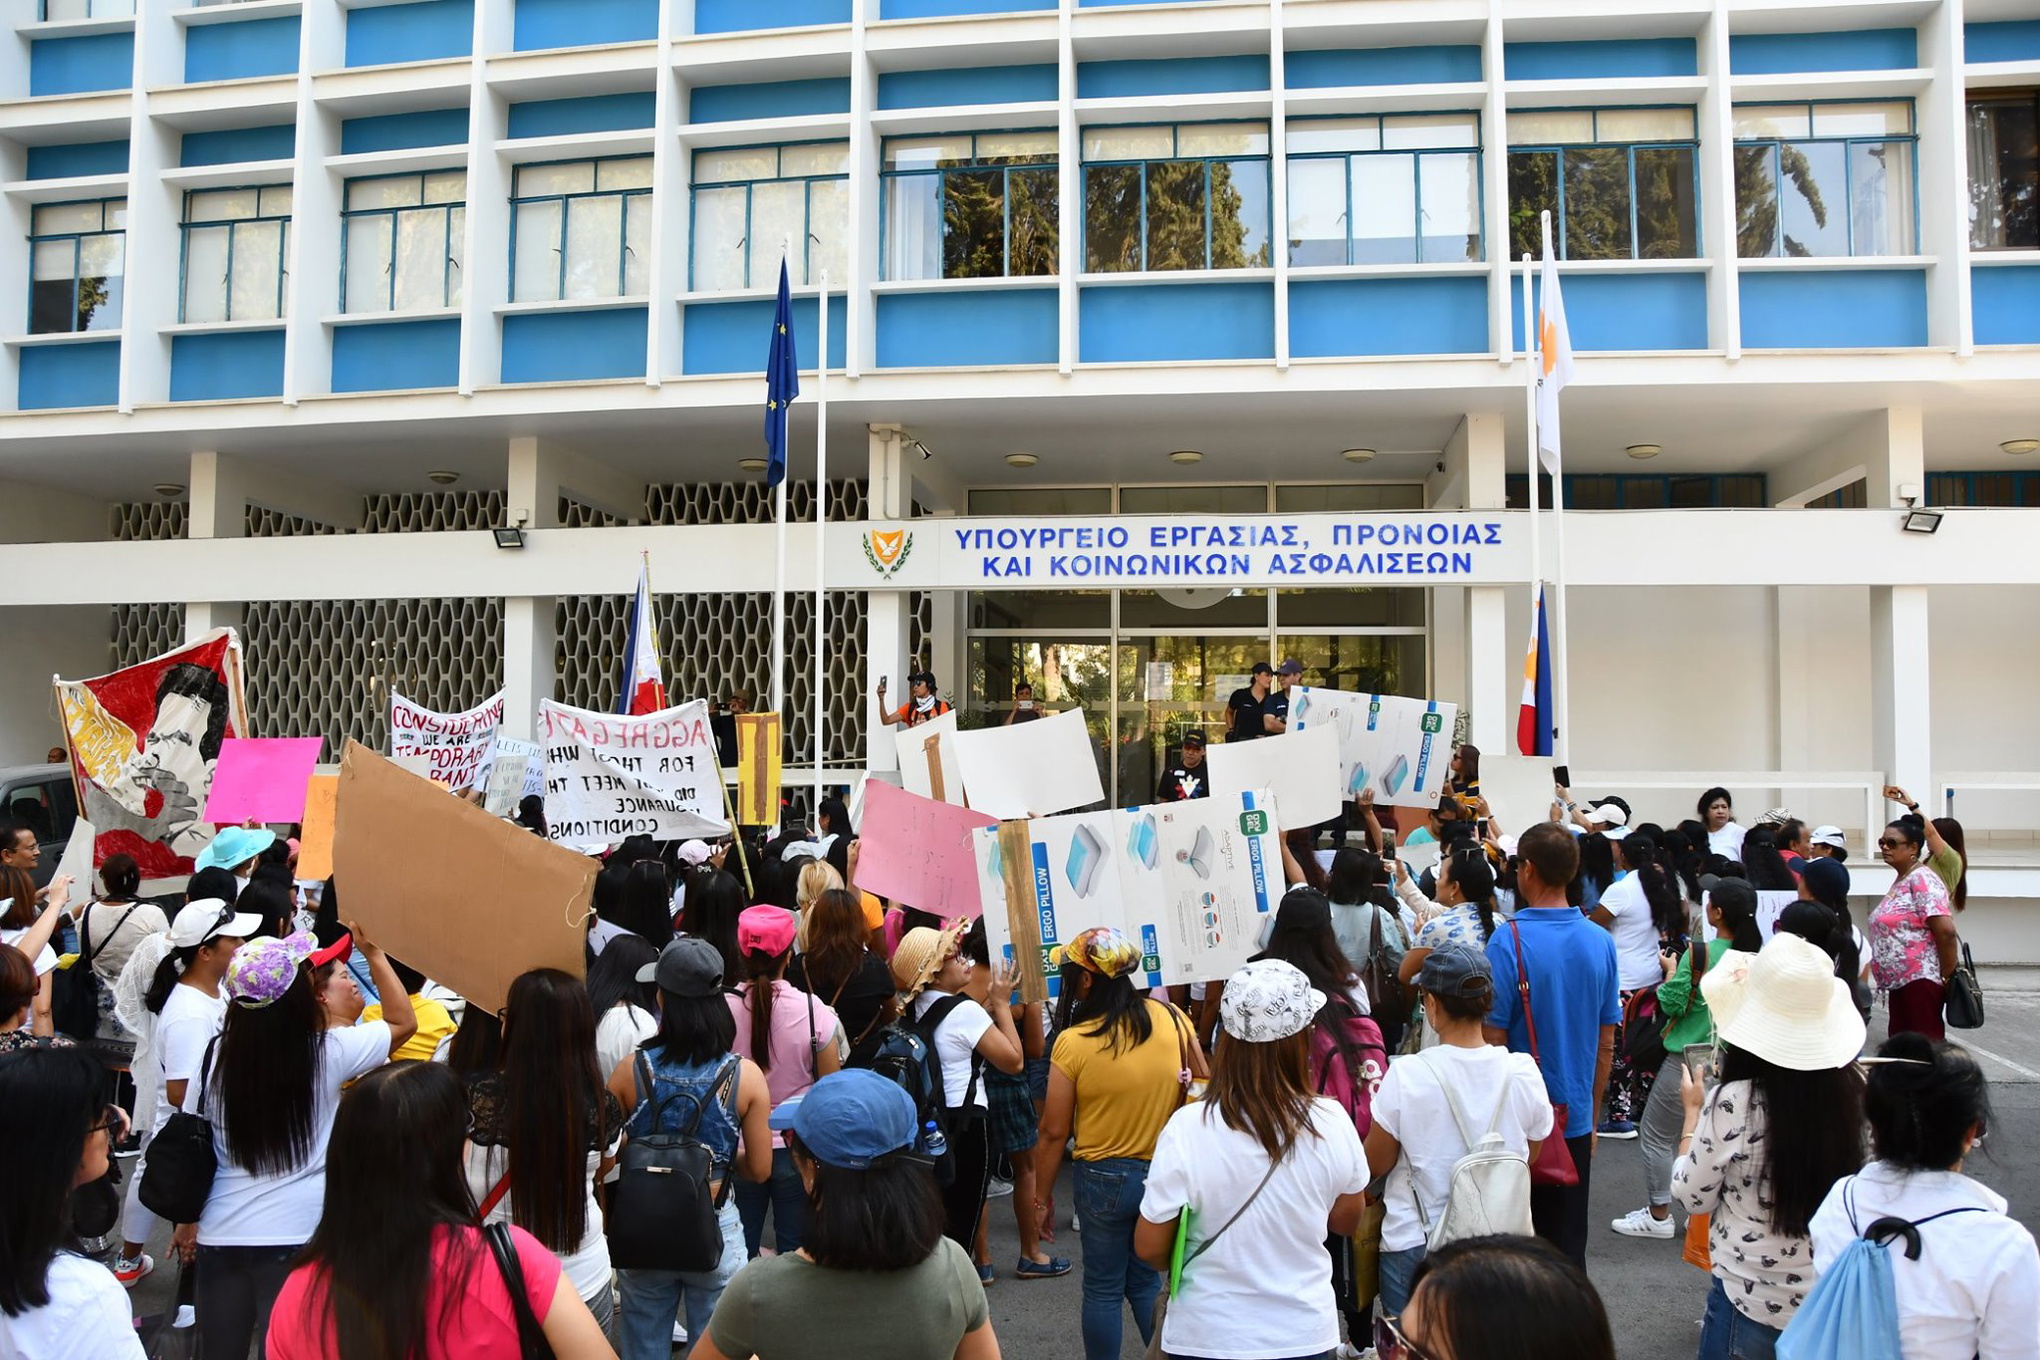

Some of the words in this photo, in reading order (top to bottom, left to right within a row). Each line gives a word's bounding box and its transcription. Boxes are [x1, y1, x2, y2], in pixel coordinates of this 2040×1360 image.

[955, 527, 1129, 550] ΥΠΟΥΡΓΕΙΟ
[1150, 525, 1309, 551] ΕΡΓΑΣΙΑΣ,
[1332, 523, 1503, 546] ΠΡΟΝΟΙΑΣ
[983, 555, 1031, 578] ΚΑΙ
[1050, 554, 1250, 577] ΚΟΙΝΩΝΙΚΩΝ
[1268, 552, 1473, 576] ΑΣΦΑΛΙΣΕΩΝ
[422, 735, 440, 747] WE
[446, 735, 471, 747] ARE
[1249, 839, 1260, 862] ERGO
[1037, 867, 1051, 908] PILLOW
[1254, 863, 1265, 894] PILLOW
[1042, 910, 1054, 939] ERGO
